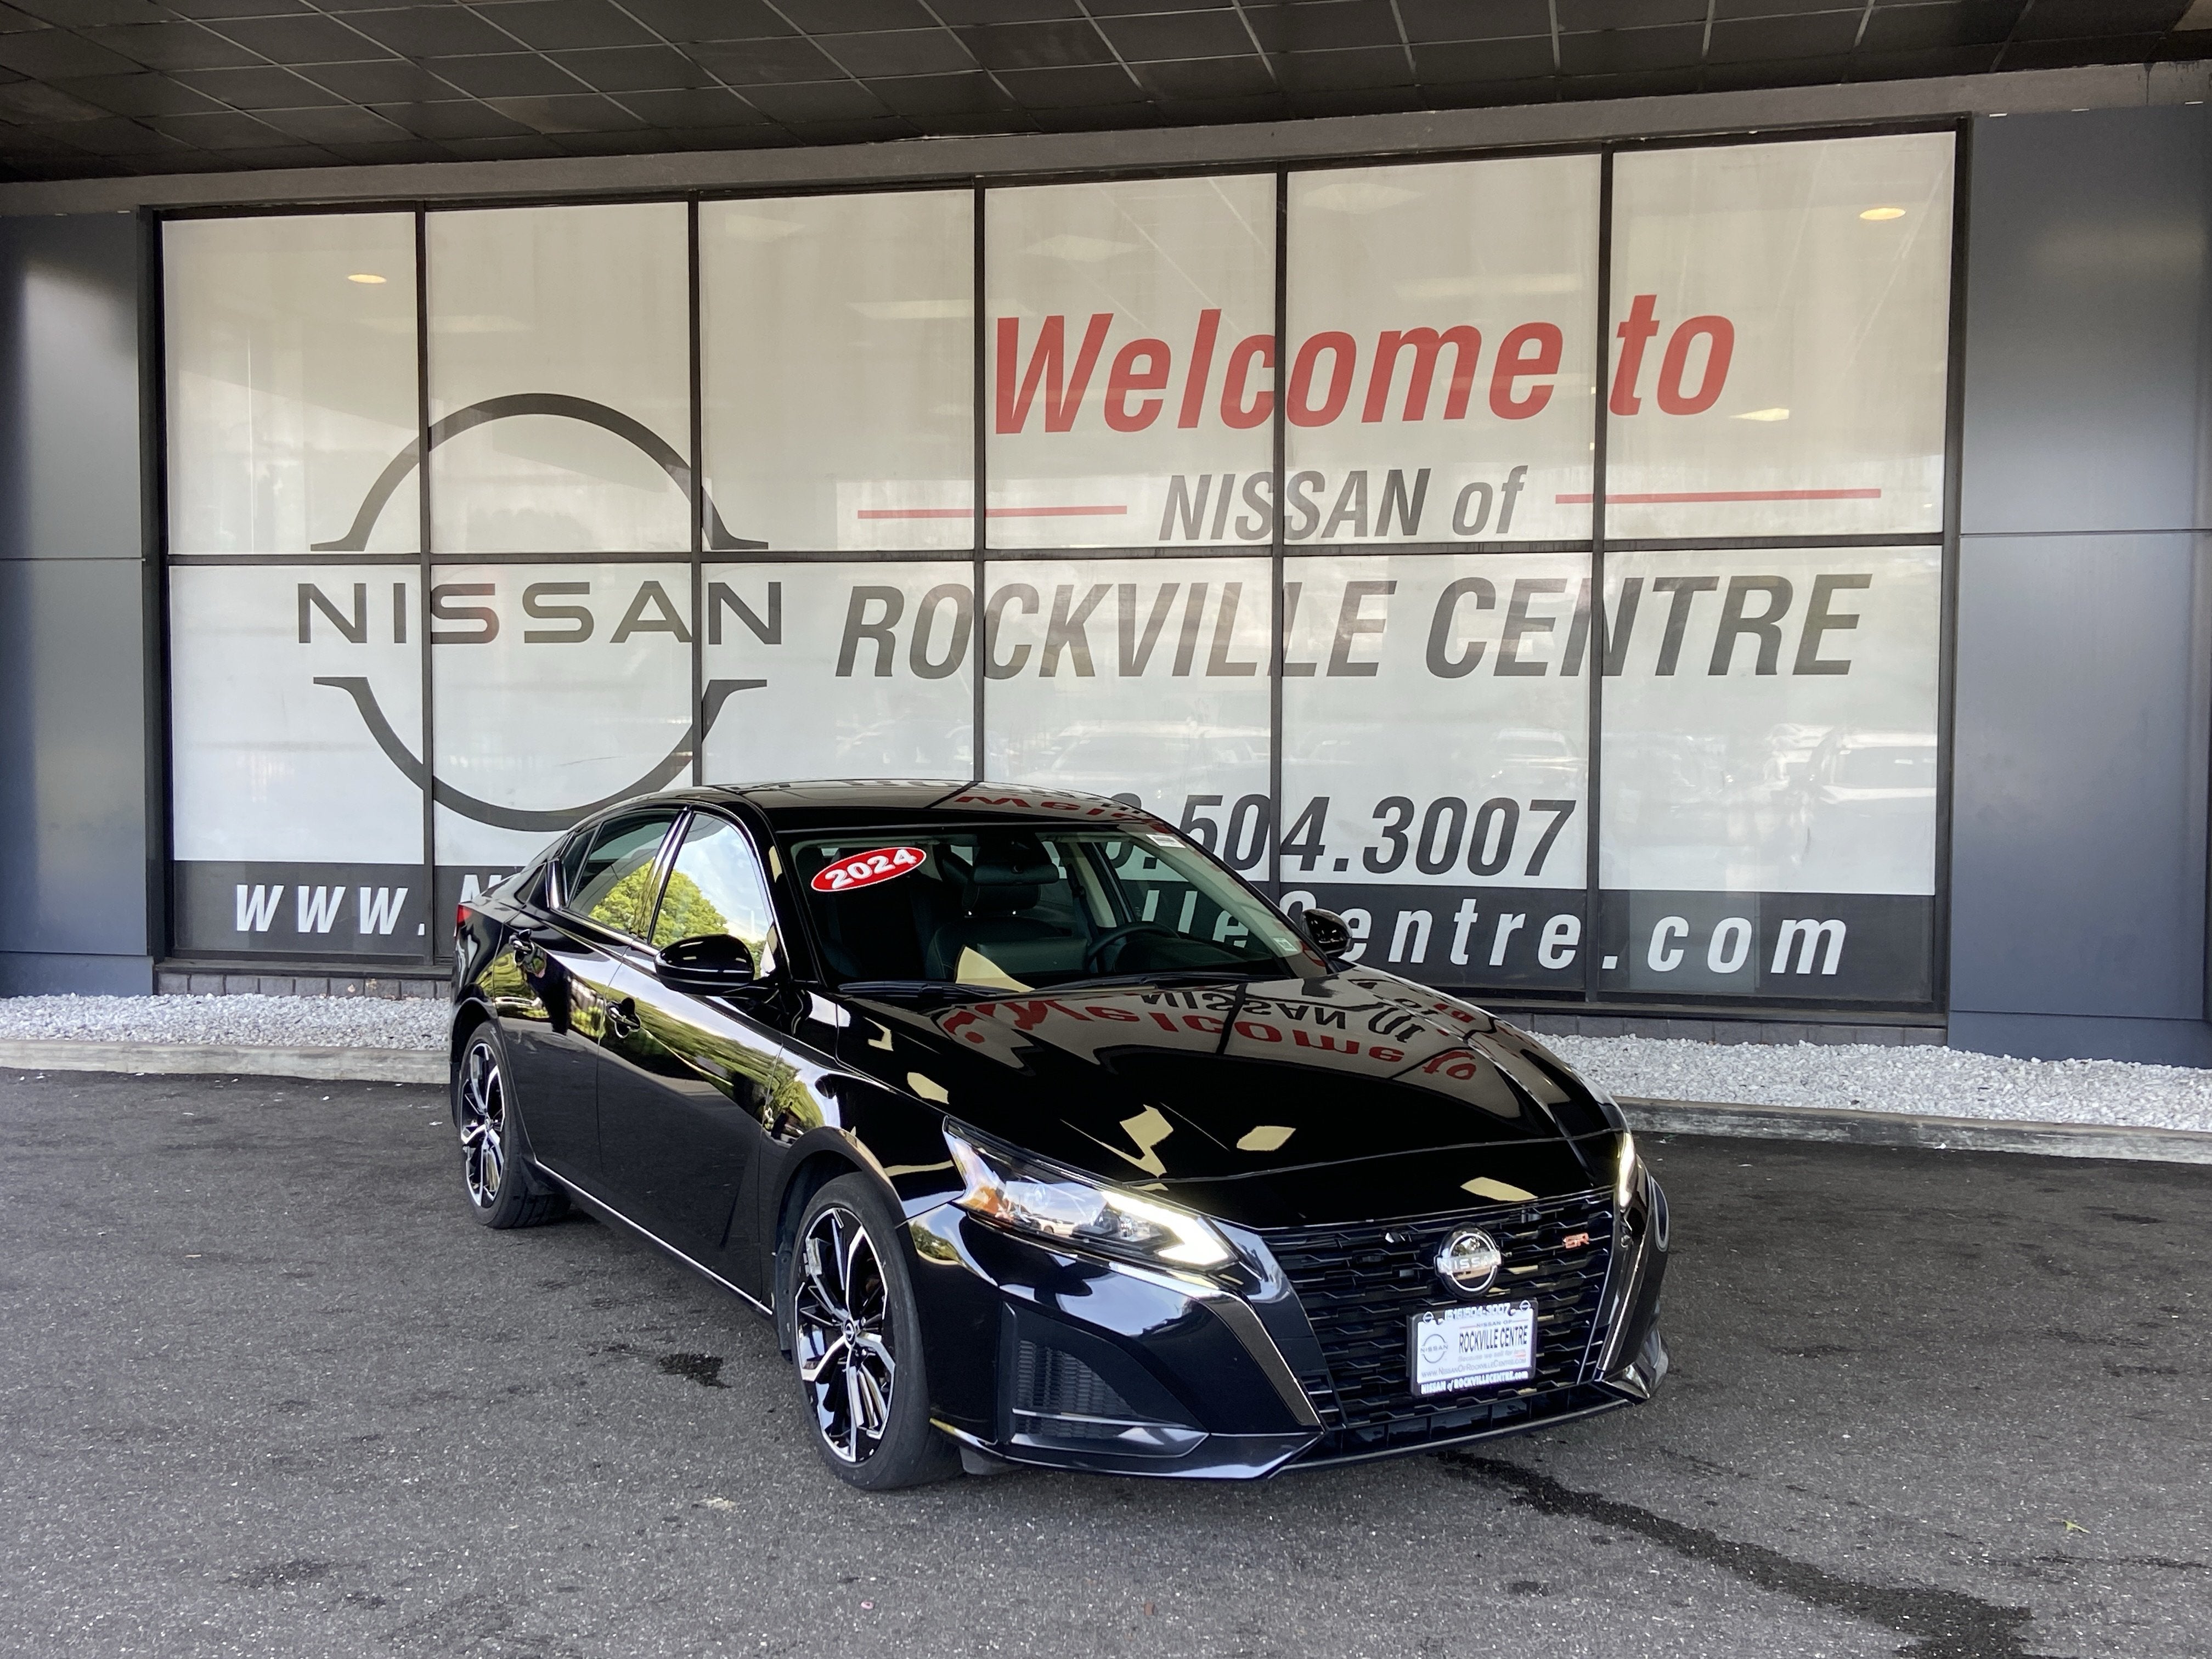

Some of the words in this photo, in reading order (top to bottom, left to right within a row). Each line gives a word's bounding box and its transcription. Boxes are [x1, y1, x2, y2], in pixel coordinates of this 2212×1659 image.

[995, 309, 1564, 435] Welcome
[1609, 294, 1736, 416] to
[1158, 468, 1431, 542] NISSAN
[1451, 465, 1528, 537] of
[297, 580, 782, 645] NISSAN
[835, 580, 1397, 679] ROCKVILLE
[1425, 574, 1873, 679] CENTRE
[825, 848, 918, 889] 2024
[1437, 1253, 1500, 1272] NISSAN
[1459, 1329, 1498, 1353] ROCKVILLE
[1500, 1325, 1528, 1347] CENTRE
[1421, 1381, 1446, 1395] NISSAN
